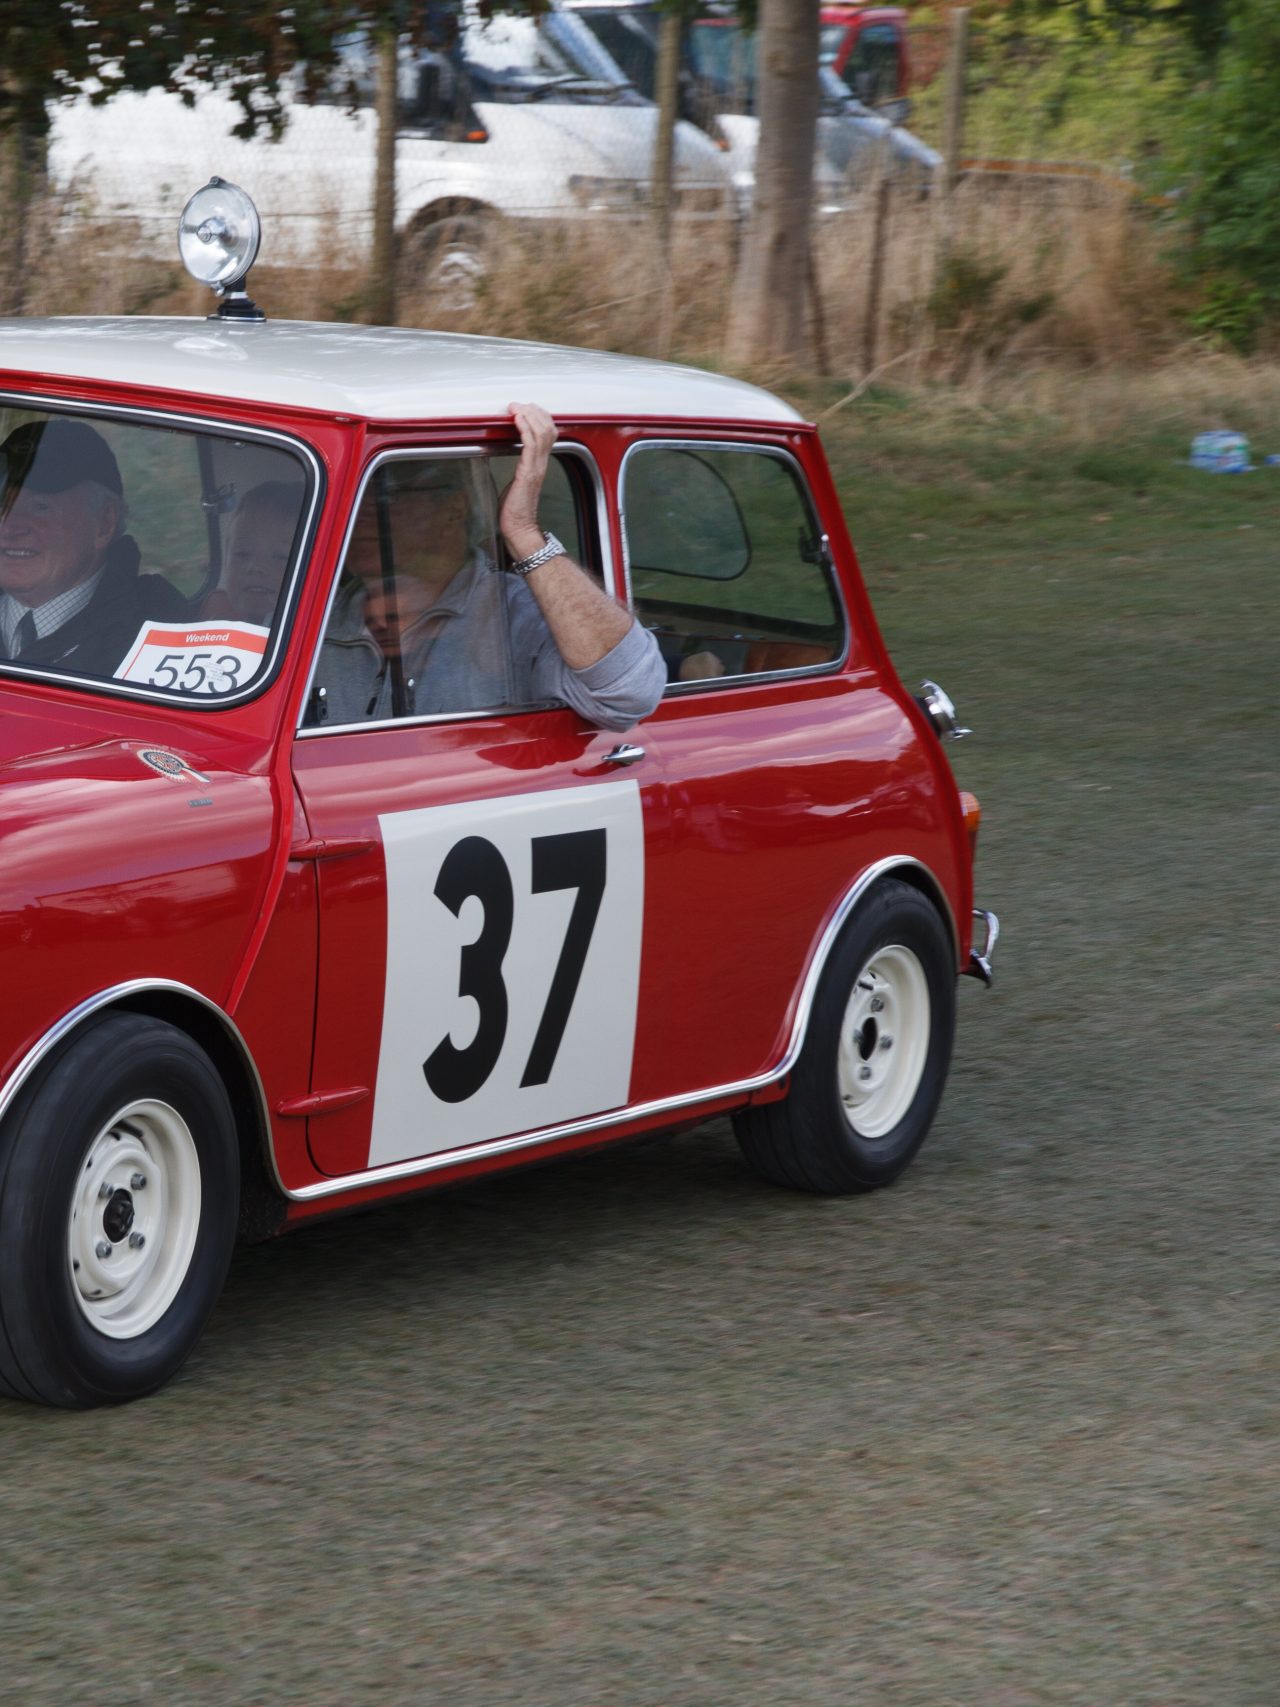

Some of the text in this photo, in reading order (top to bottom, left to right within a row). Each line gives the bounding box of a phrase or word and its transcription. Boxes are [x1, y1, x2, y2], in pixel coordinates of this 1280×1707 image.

[185, 632, 230, 643] Weekend
[148, 653, 242, 693] 553
[422, 827, 607, 1103] 37
